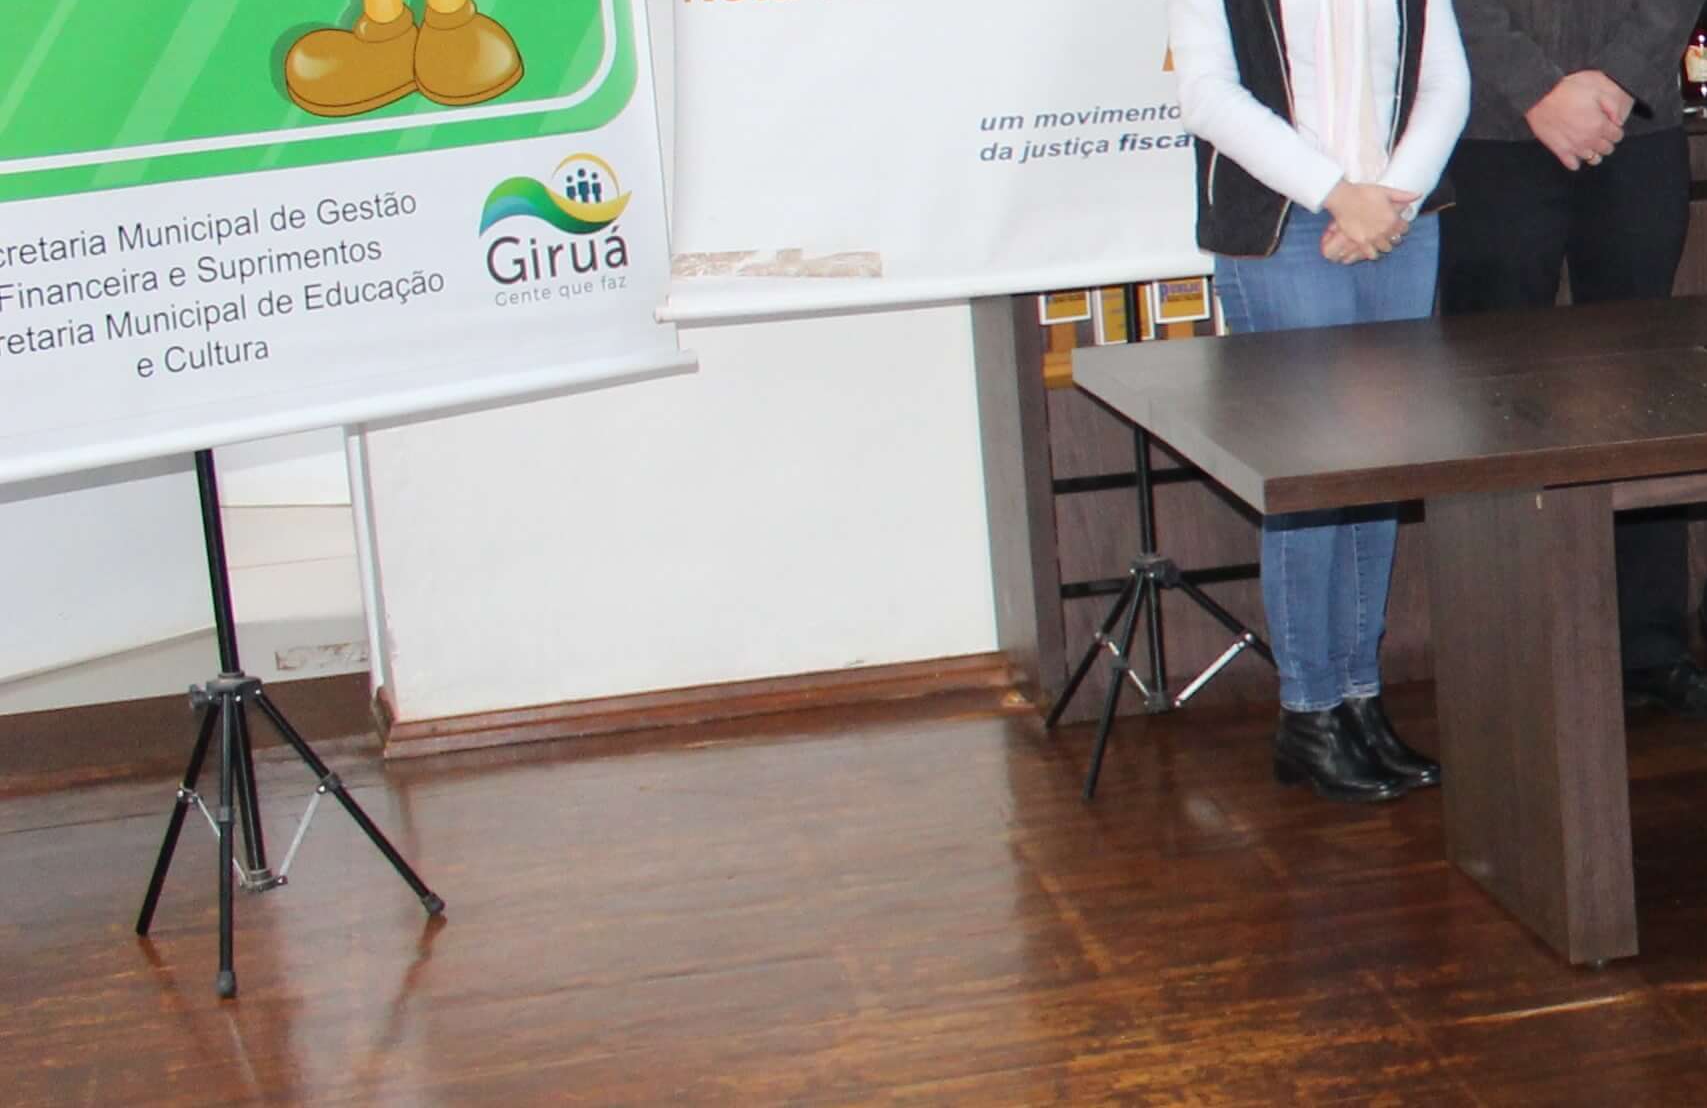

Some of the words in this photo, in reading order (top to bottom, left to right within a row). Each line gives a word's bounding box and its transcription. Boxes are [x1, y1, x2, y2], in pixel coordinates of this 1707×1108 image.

[979, 114, 1025, 132] um
[1033, 102, 1182, 130] movimento
[979, 142, 1014, 163] da
[1017, 136, 1110, 165] justiça
[1118, 132, 1192, 152] fisca
[117, 207, 260, 253] Municipal
[269, 204, 307, 233] de
[316, 191, 417, 226] Gestão
[168, 266, 187, 288] e
[197, 239, 383, 285] Suprimentos
[486, 224, 629, 285] Giruá
[105, 294, 247, 341] Municipal
[257, 289, 294, 318] de
[303, 270, 445, 311] Educação
[494, 287, 552, 308] Gente
[558, 280, 595, 300] que
[600, 275, 628, 291] faz
[137, 356, 155, 379] e
[164, 339, 270, 374] Cultura
